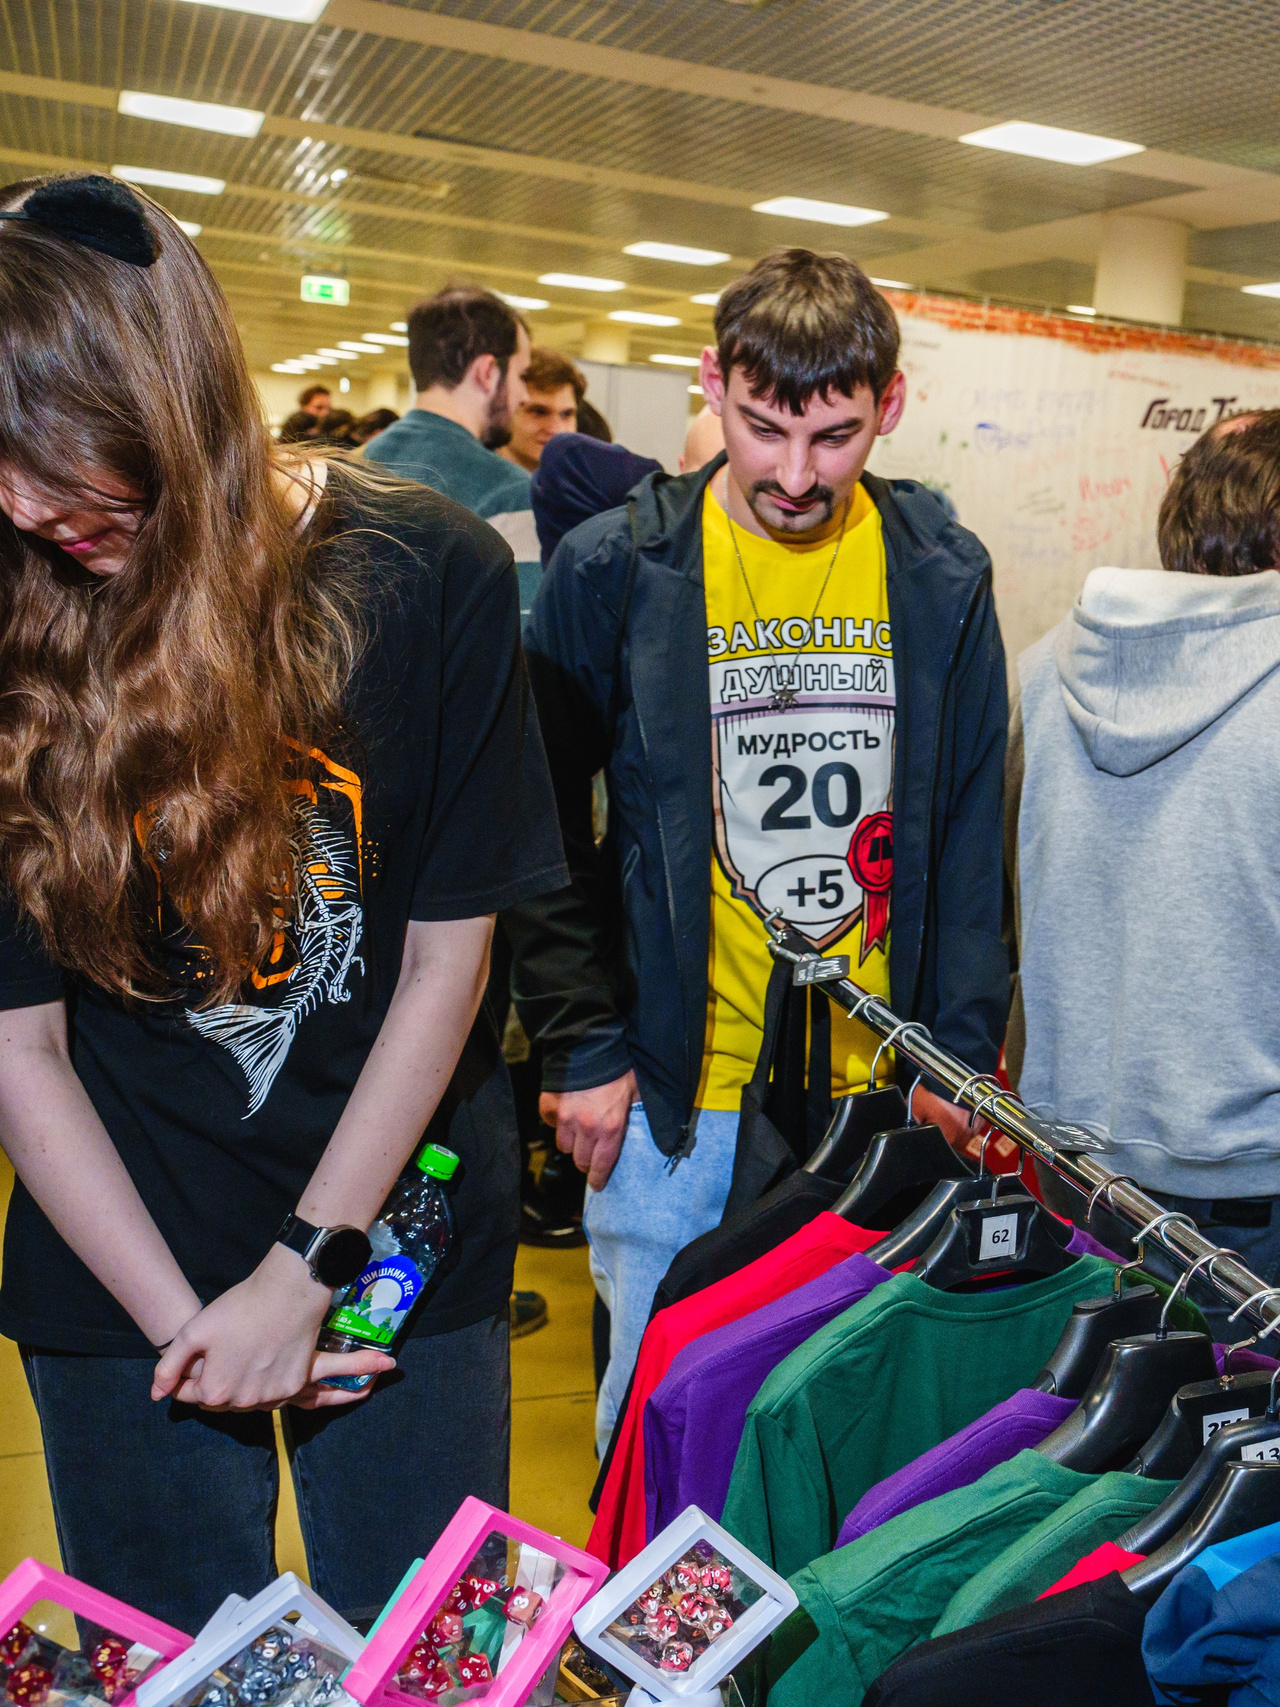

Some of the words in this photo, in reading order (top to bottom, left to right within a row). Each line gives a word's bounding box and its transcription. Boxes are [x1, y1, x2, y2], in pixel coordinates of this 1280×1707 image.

[721, 659, 887, 704] ДУШНЫЙ
[737, 730, 881, 758] МУДРОСТЬ
[758, 762, 862, 831] 20
[786, 869, 844, 909] +5
[991, 1228, 1009, 1244] 62
[360, 1267, 407, 1285] ШИШКИН
[402, 1279, 414, 1297] ЛЕС
